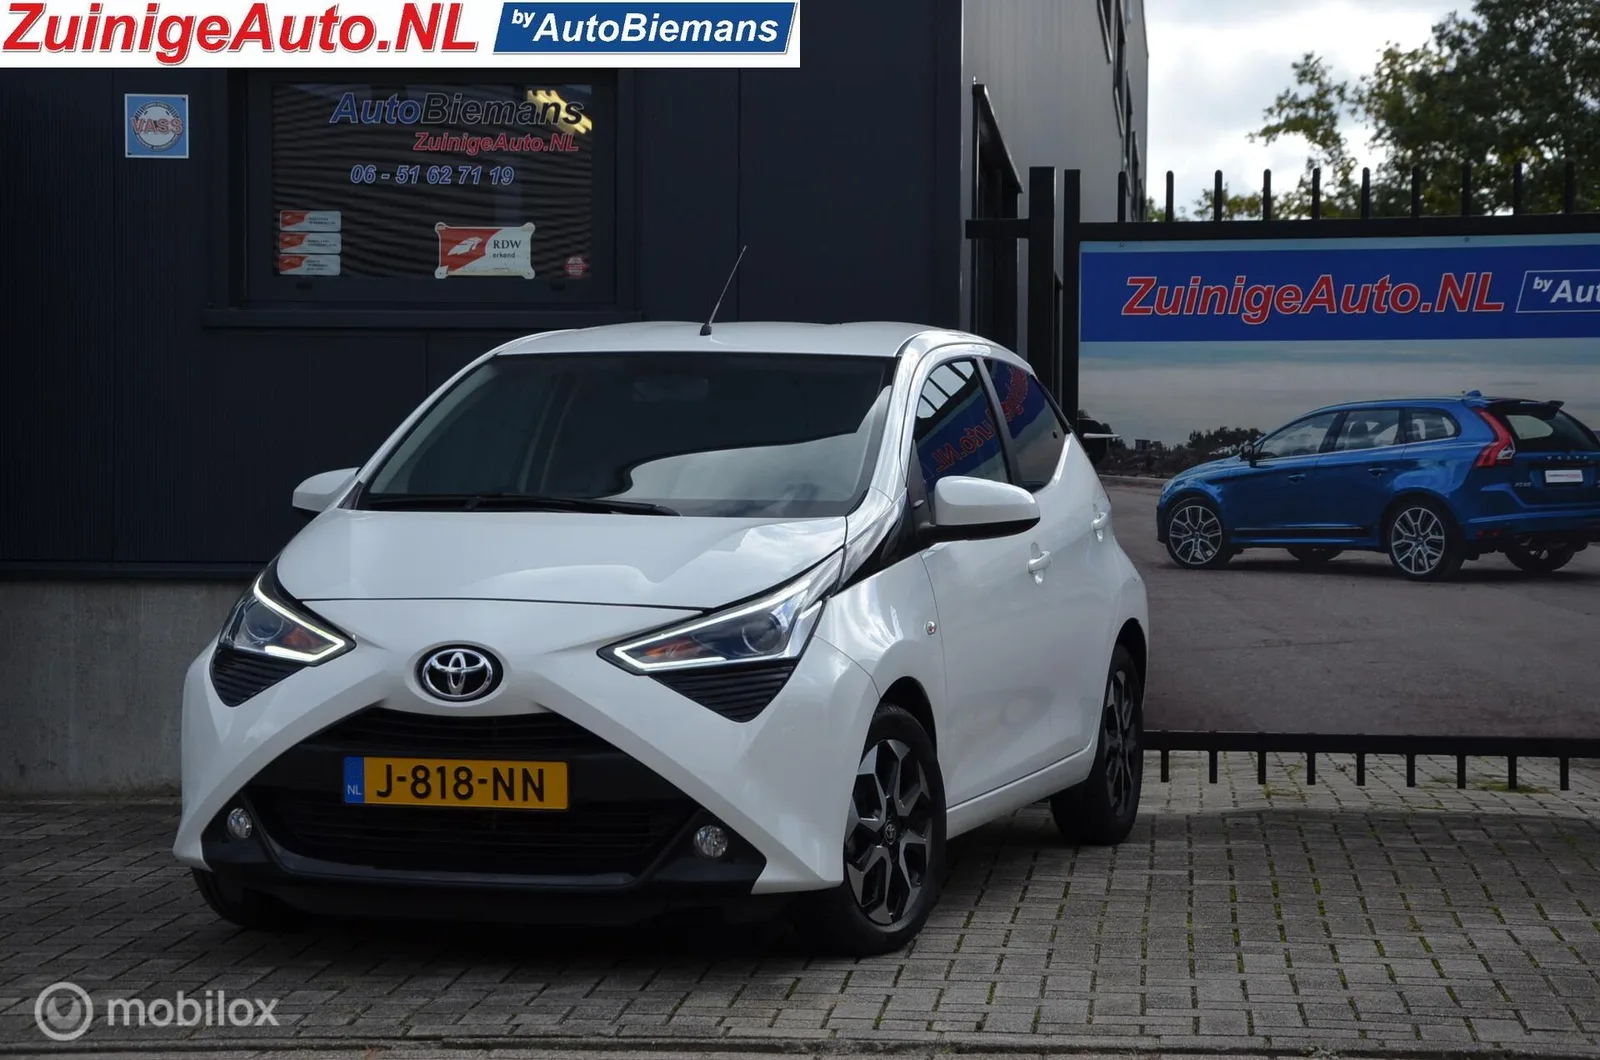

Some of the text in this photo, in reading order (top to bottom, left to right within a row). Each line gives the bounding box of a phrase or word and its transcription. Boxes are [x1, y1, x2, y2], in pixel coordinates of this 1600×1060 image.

[329, 92, 585, 125] AutoBiemans
[131, 117, 183, 134] VASS
[413, 132, 579, 156] ZuinigeAuto.NL
[350, 165, 377, 184] 06
[395, 165, 420, 184] 51
[426, 165, 452, 184] 62
[458, 166, 482, 185] 71
[490, 166, 515, 185] 19
[492, 239, 522, 249] RDW
[492, 251, 516, 259] erkend
[1121, 272, 1504, 324] ZuinigeAuto.NL
[1532, 276, 1553, 293] by
[347, 784, 361, 796] NL
[376, 764, 544, 803] J-818-NN
